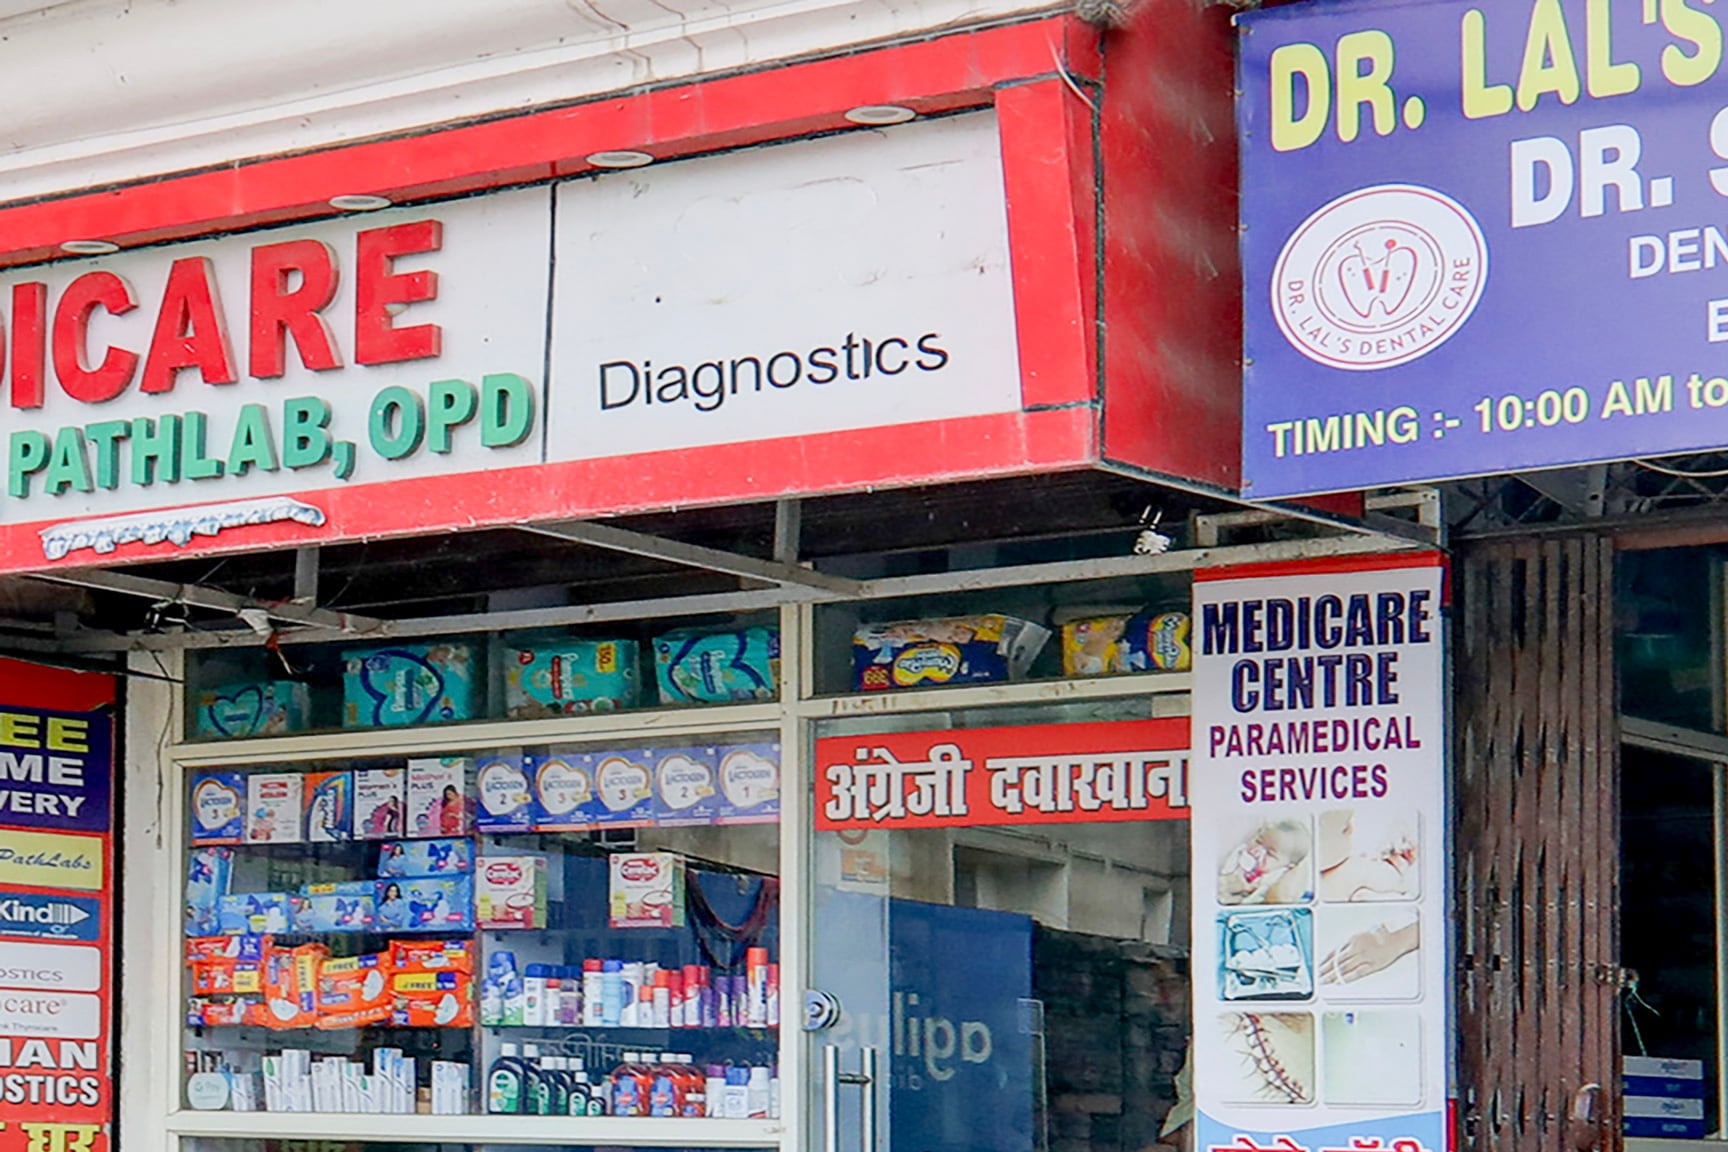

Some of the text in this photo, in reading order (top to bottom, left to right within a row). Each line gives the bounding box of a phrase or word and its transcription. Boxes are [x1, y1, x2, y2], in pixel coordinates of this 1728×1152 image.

[1269, 30, 1426, 152] DR.
[1461, 0, 1723, 119] LAL'S
[1510, 124, 1674, 228] DR.
[0, 218, 444, 410] ICARE
[1288, 256, 1471, 355] DR. LAL'S DENTAL CARE
[598, 331, 950, 412] Diagnostics
[8, 372, 536, 499] PATHLAB, OPD
[1267, 406, 1419, 458] TIMING
[1474, 386, 1588, 433] 10:00
[1601, 375, 1674, 419] AM
[1201, 590, 1431, 656] MEDICARE
[1231, 651, 1399, 713] CENTRE
[1209, 715, 1422, 758] PARAMEDICAL
[825, 743, 1191, 822] अंग्रेजी दवाखान
[1241, 764, 1388, 803] SERVICES
[0, 997, 62, 1015] care
[0, 1074, 100, 1106] STICS
